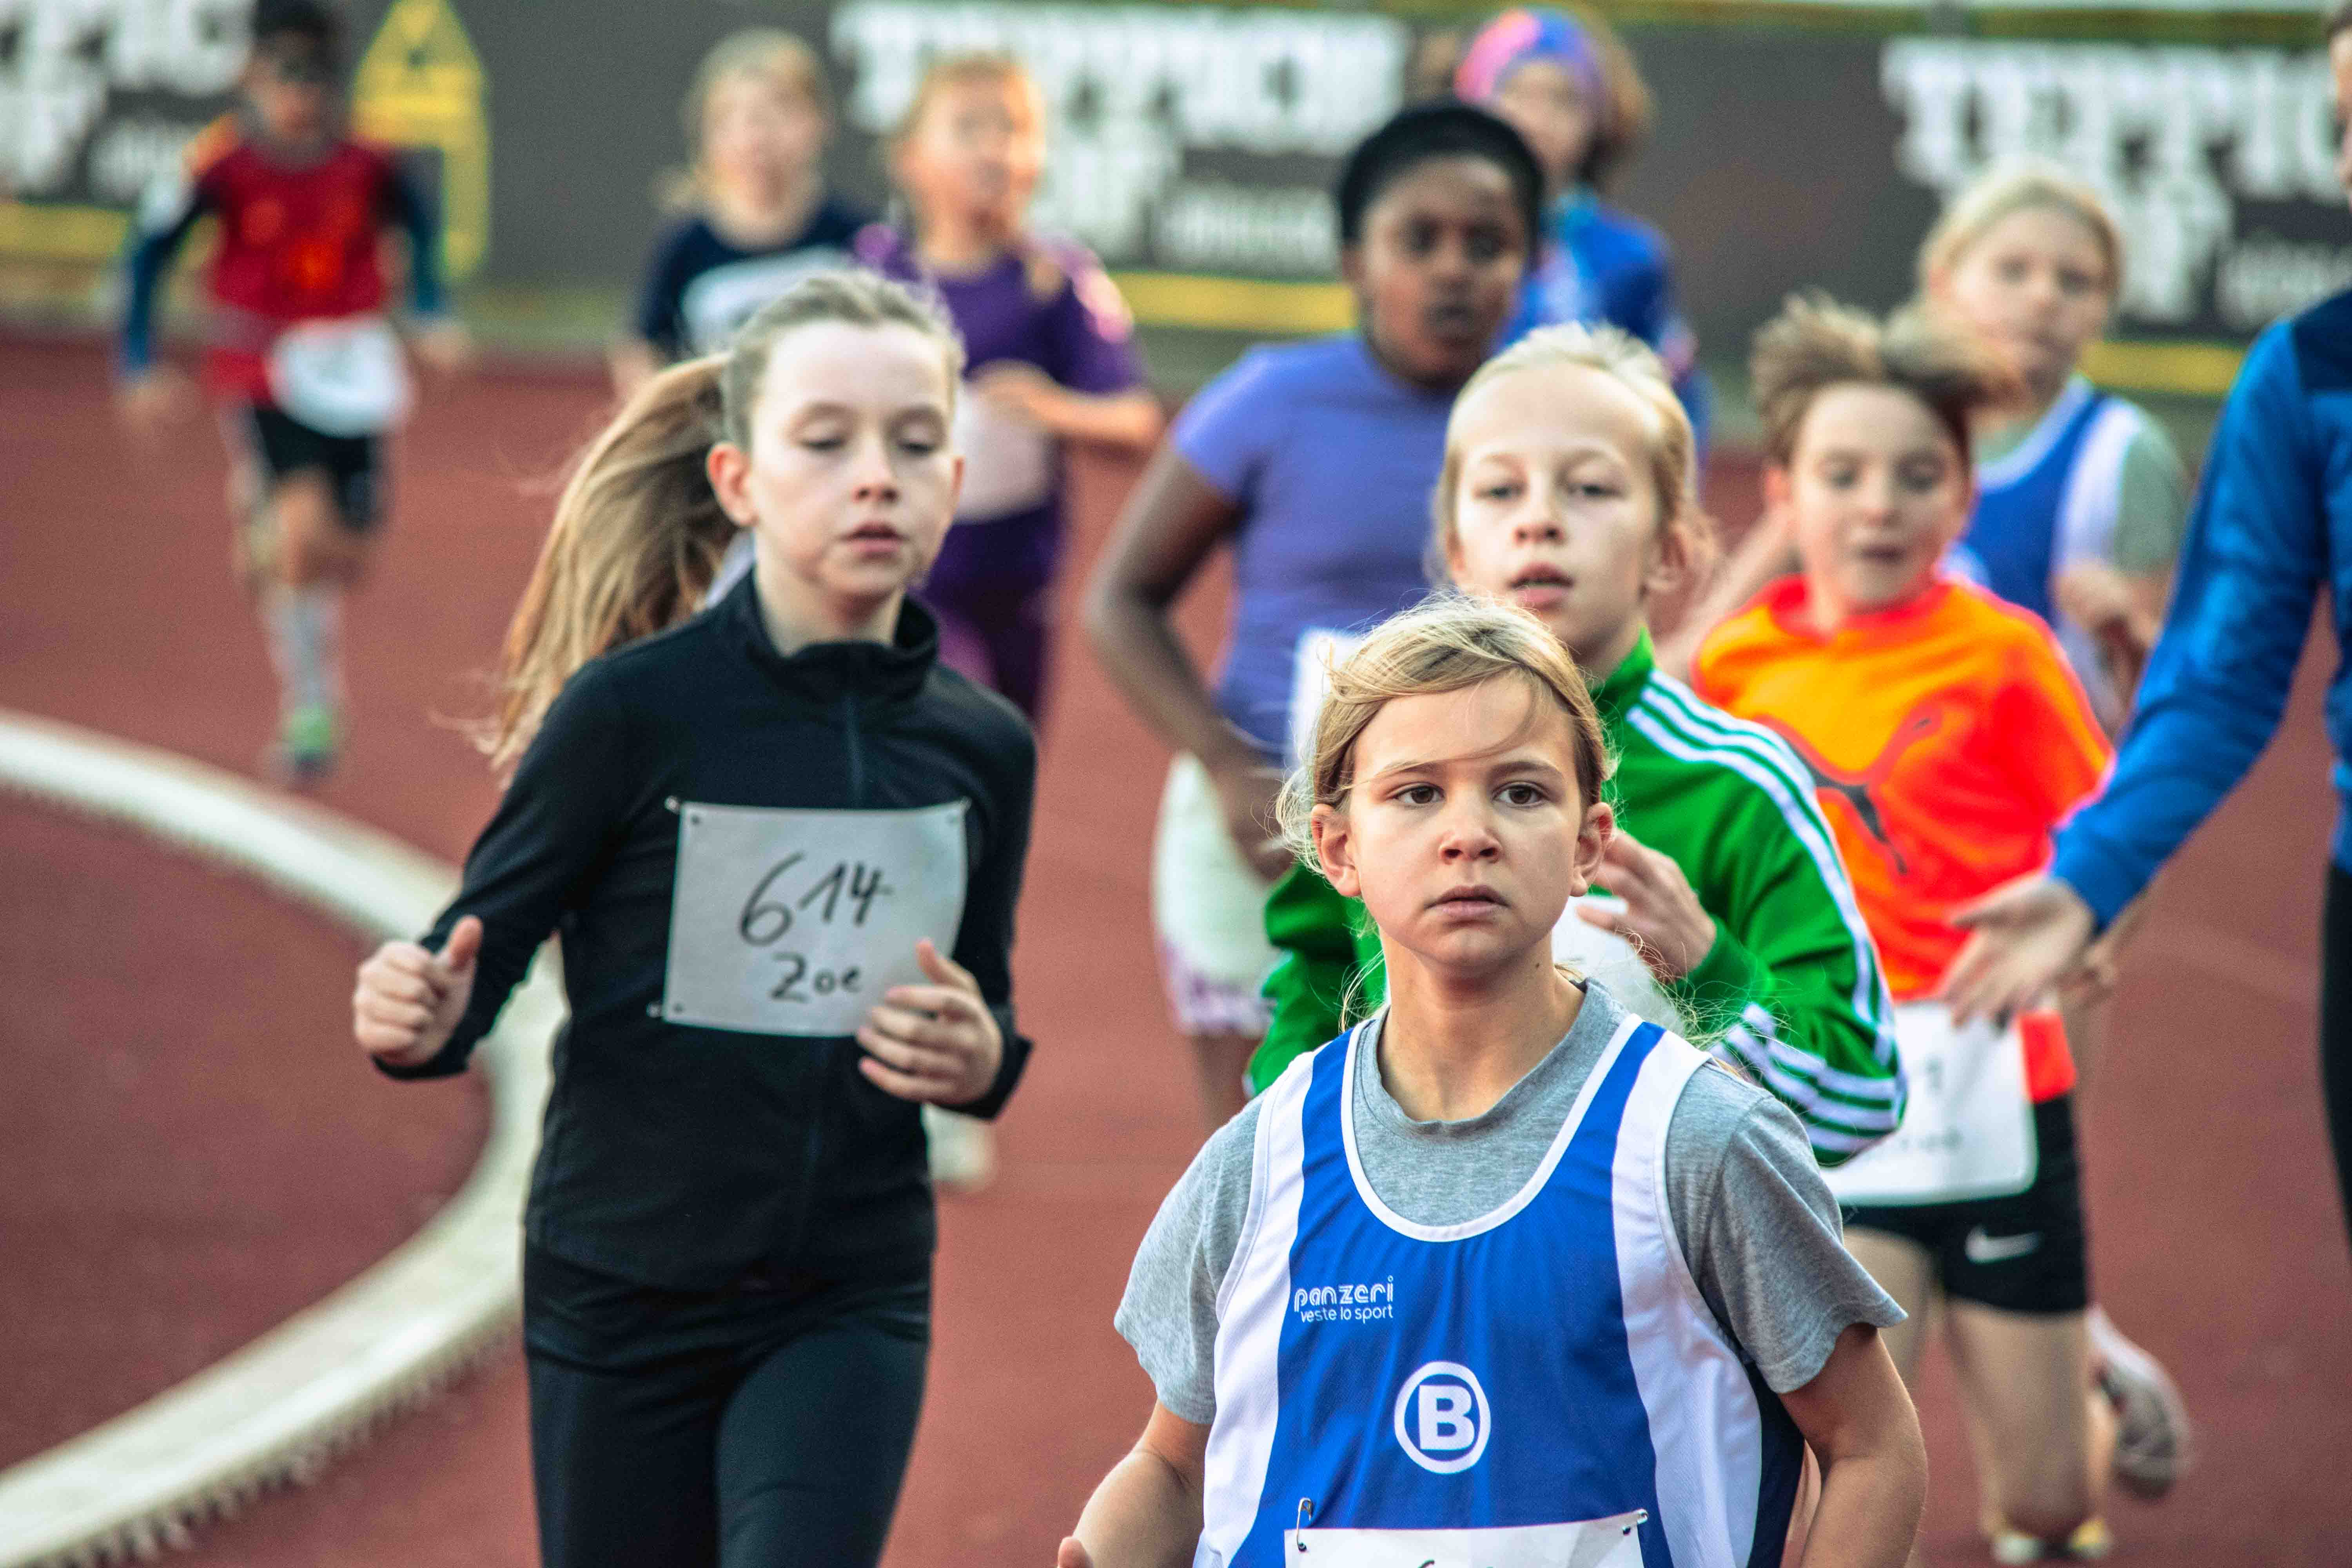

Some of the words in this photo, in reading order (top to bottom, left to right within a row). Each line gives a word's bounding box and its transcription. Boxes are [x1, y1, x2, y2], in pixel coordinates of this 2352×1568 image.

[739, 851, 895, 946] 614
[1294, 1274, 1394, 1312] panzeri
[1300, 1307, 1337, 1323] veste
[1340, 1307, 1352, 1321] lo
[1355, 1304, 1393, 1324] sport
[1419, 1384, 1475, 1451] B
